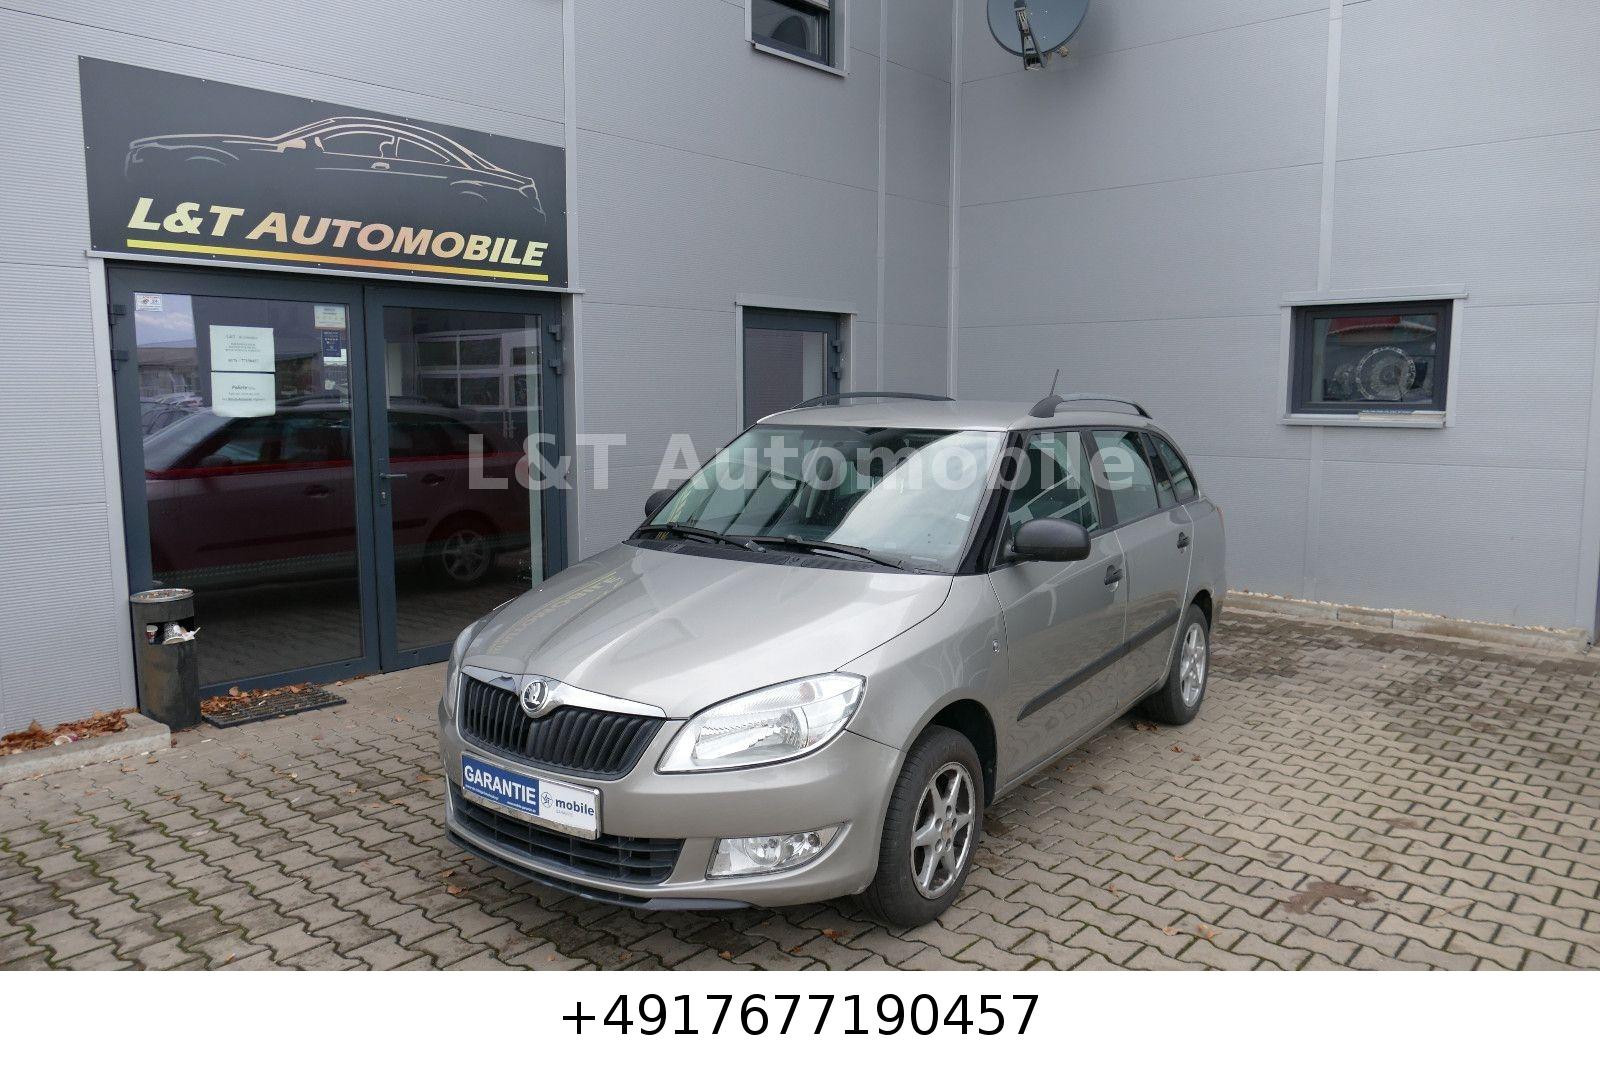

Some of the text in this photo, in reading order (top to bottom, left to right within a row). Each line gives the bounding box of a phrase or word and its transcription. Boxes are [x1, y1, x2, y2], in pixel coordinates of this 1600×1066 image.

[127, 197, 549, 268] L&T AUTOMOBILE
[464, 765, 537, 806] GARANTIE
[555, 798, 595, 817] mobile
